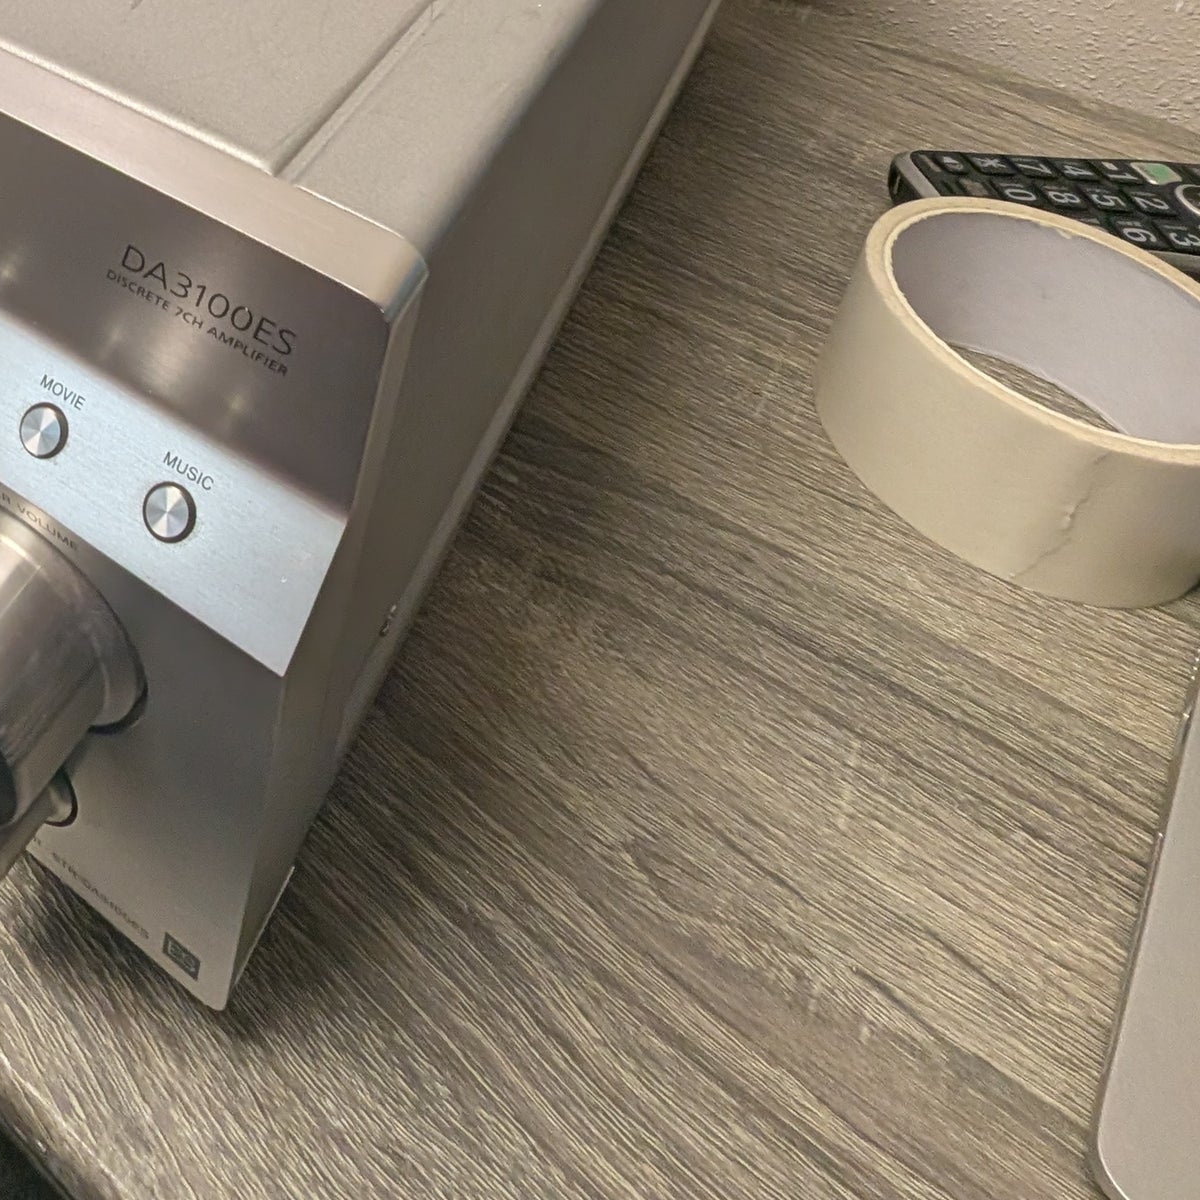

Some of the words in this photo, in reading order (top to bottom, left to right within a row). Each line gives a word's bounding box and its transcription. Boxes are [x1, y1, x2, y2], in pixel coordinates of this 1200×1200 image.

[1048, 191, 1081, 204] 8
[1091, 194, 1127, 208] 5
[1134, 196, 1170, 210] 2
[1122, 227, 1157, 242] 6
[121, 244, 297, 356] DA3100ES
[106, 269, 171, 311] DISCRETE
[174, 307, 204, 329] 7CH
[206, 326, 289, 377] AMPLIFIER
[39, 374, 86, 411] MOVIE
[162, 451, 214, 491] MUSIC
[16, 503, 79, 551] VOLUME
